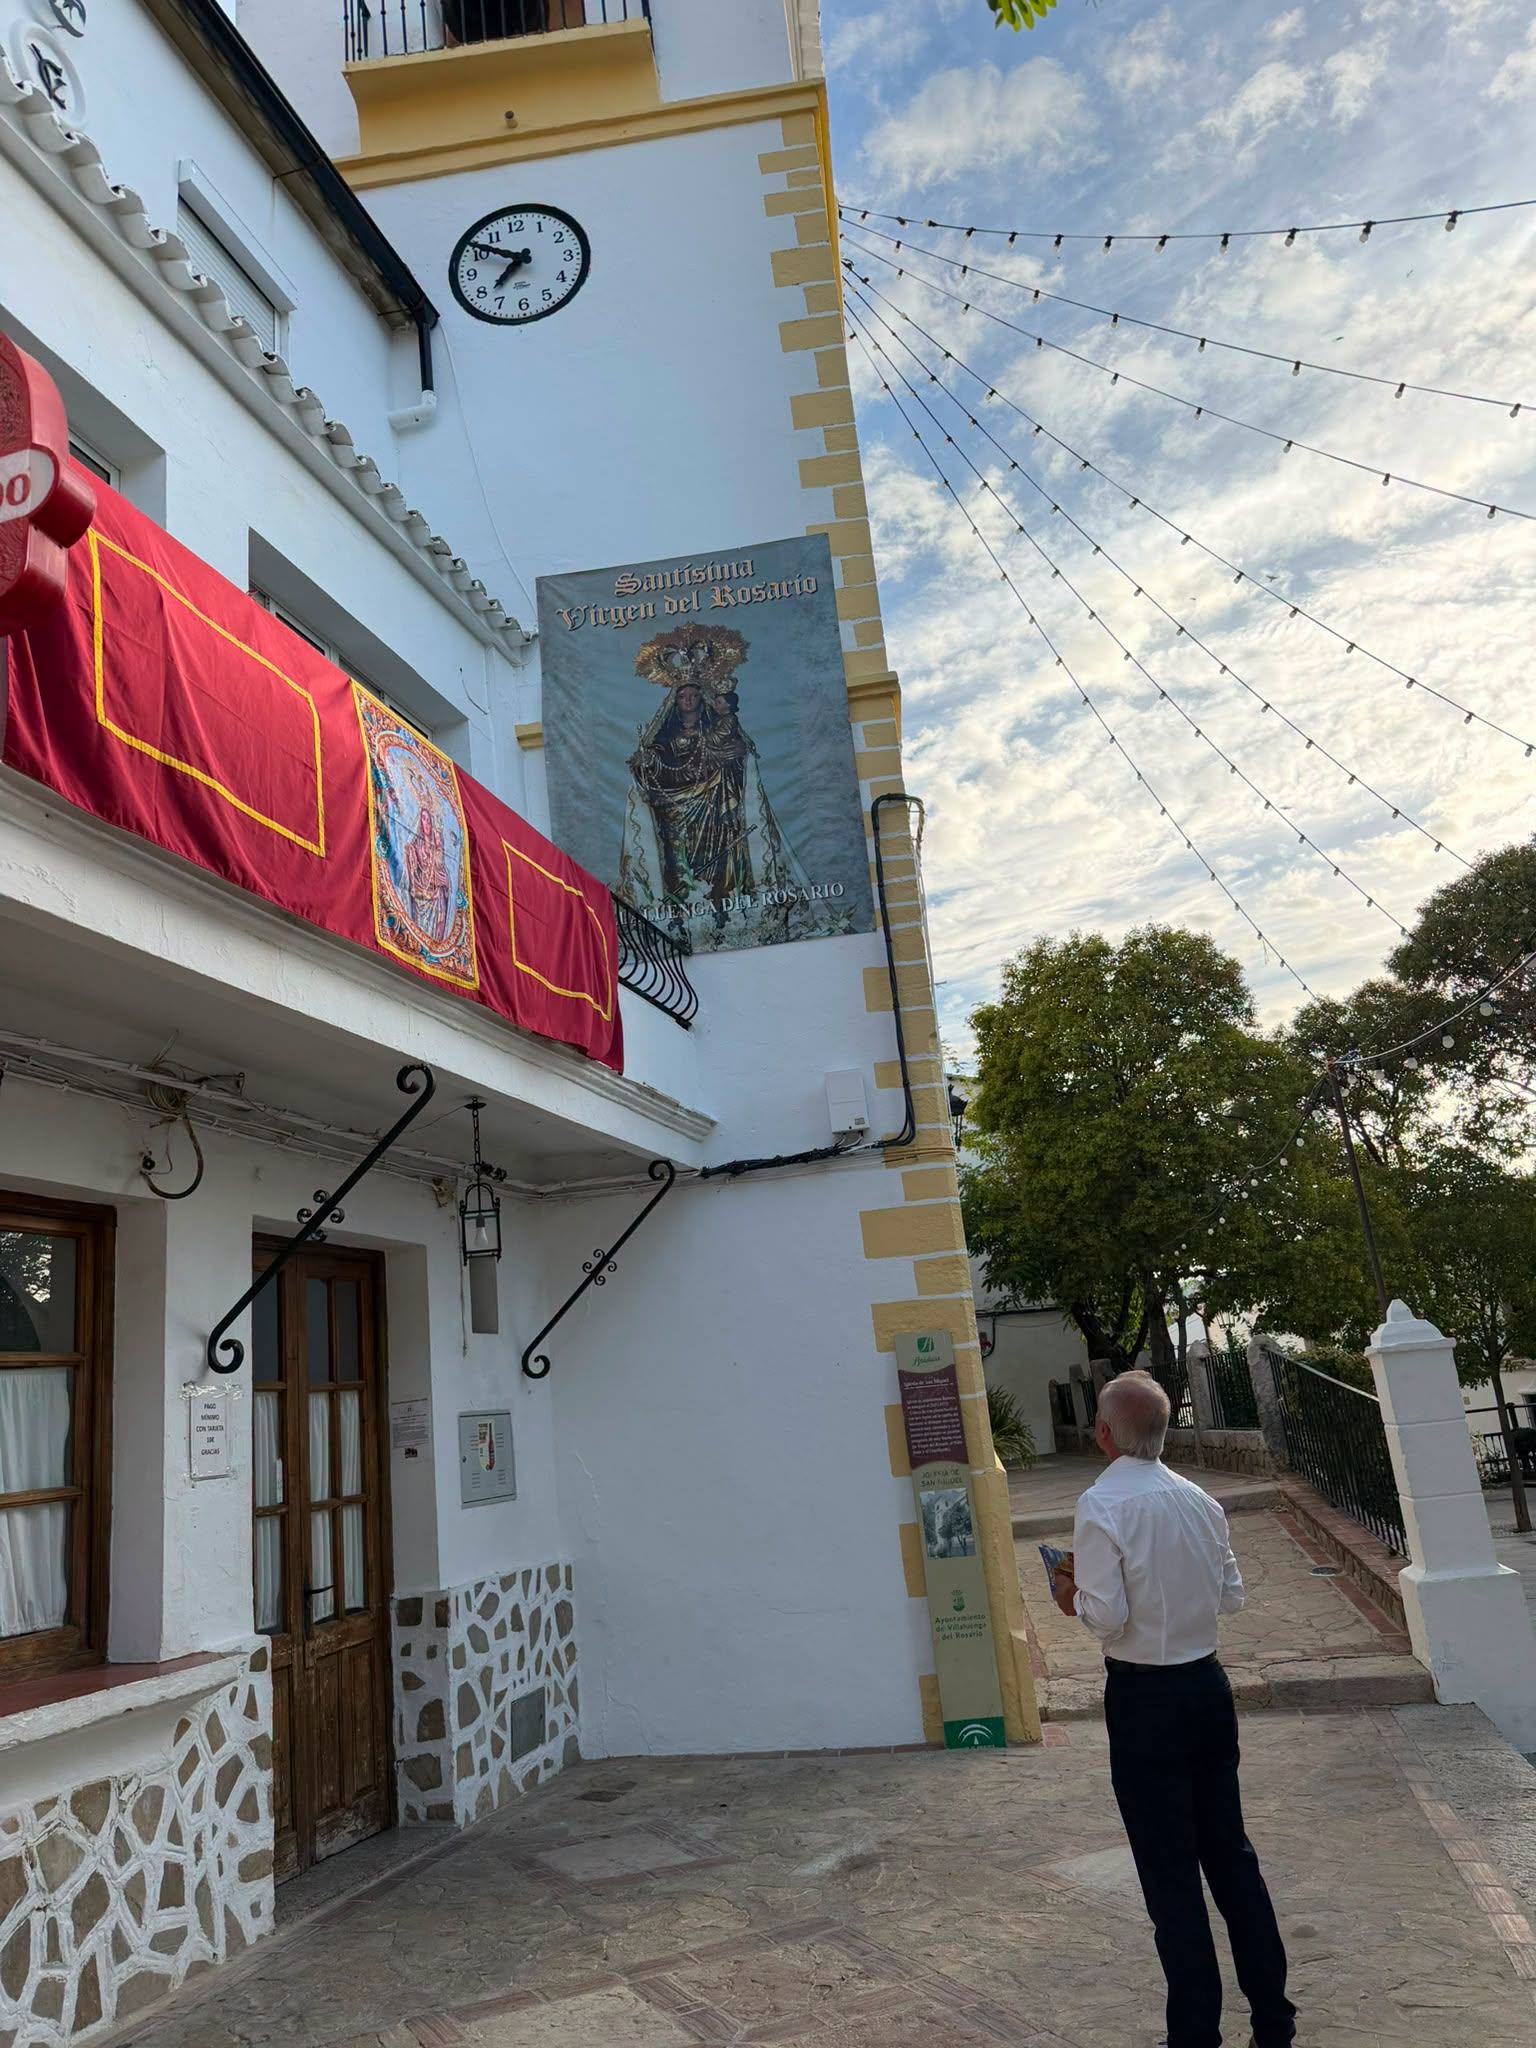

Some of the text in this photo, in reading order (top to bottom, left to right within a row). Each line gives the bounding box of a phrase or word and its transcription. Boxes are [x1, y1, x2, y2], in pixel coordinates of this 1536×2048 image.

[507, 220, 525, 233] 12
[536, 221, 544, 233] 1
[488, 231, 501, 244] 11
[553, 231, 565, 243] 2
[563, 249, 574, 262] 3
[466, 268, 477, 281] 9
[556, 270, 567, 283] 4
[476, 286, 488, 299] 8
[541, 288, 552, 301] 5
[494, 296, 505, 310] 7
[518, 298, 530, 311] 6
[614, 559, 754, 597] Santísima
[556, 573, 818, 631] Virgen del Rosario
[721, 895, 759, 913] DEL
[761, 882, 845, 906] ROSARIO
[935, 1614, 986, 1624] Ayuntamiento
[955, 1631, 983, 1639] Rosario
